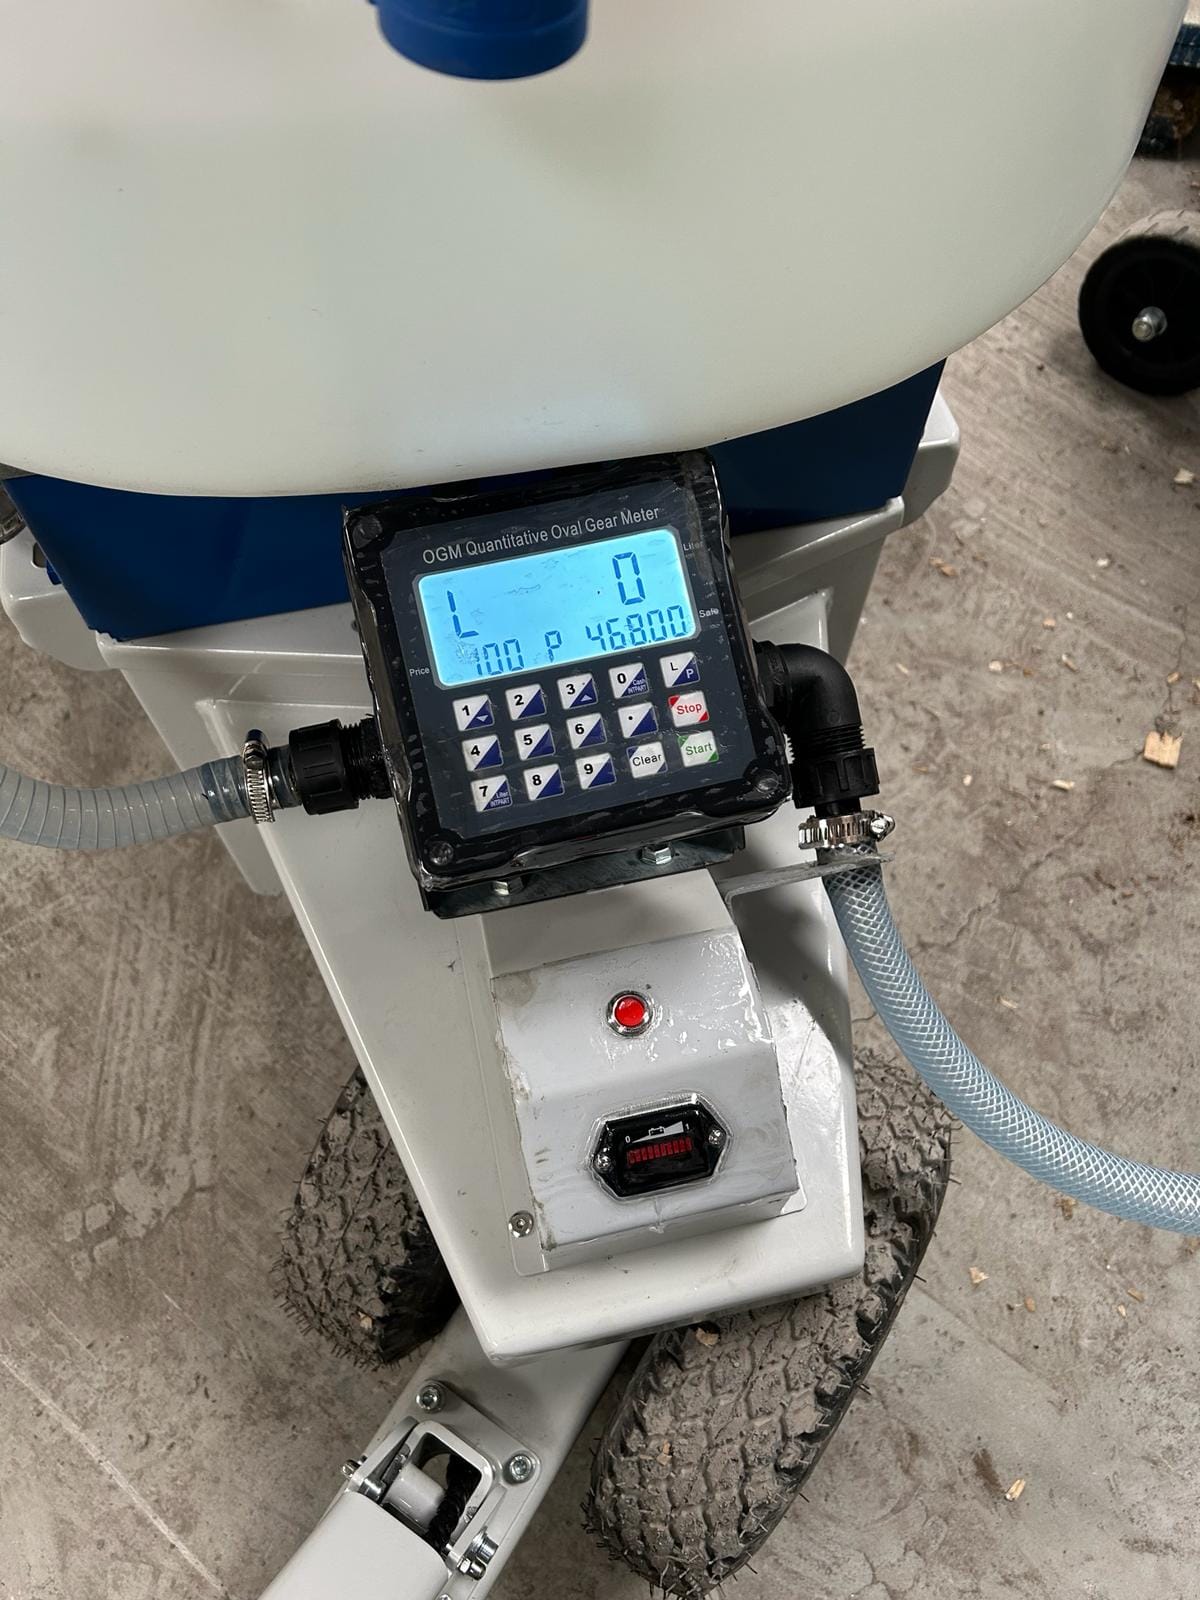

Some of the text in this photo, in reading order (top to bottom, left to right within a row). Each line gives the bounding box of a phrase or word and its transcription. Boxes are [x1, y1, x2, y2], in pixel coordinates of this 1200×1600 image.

[422, 507, 660, 564] OGM Quantitative Oval Gear Meter
[612, 552, 646, 605] 0
[409, 667, 430, 677] Price
[544, 630, 563, 662] P
[462, 662, 679, 717] 1 2 3 0 L
[686, 669, 694, 679] P
[470, 703, 702, 757] 4 5 6 Stop
[479, 743, 713, 797] 7 8 9 Clear Start
